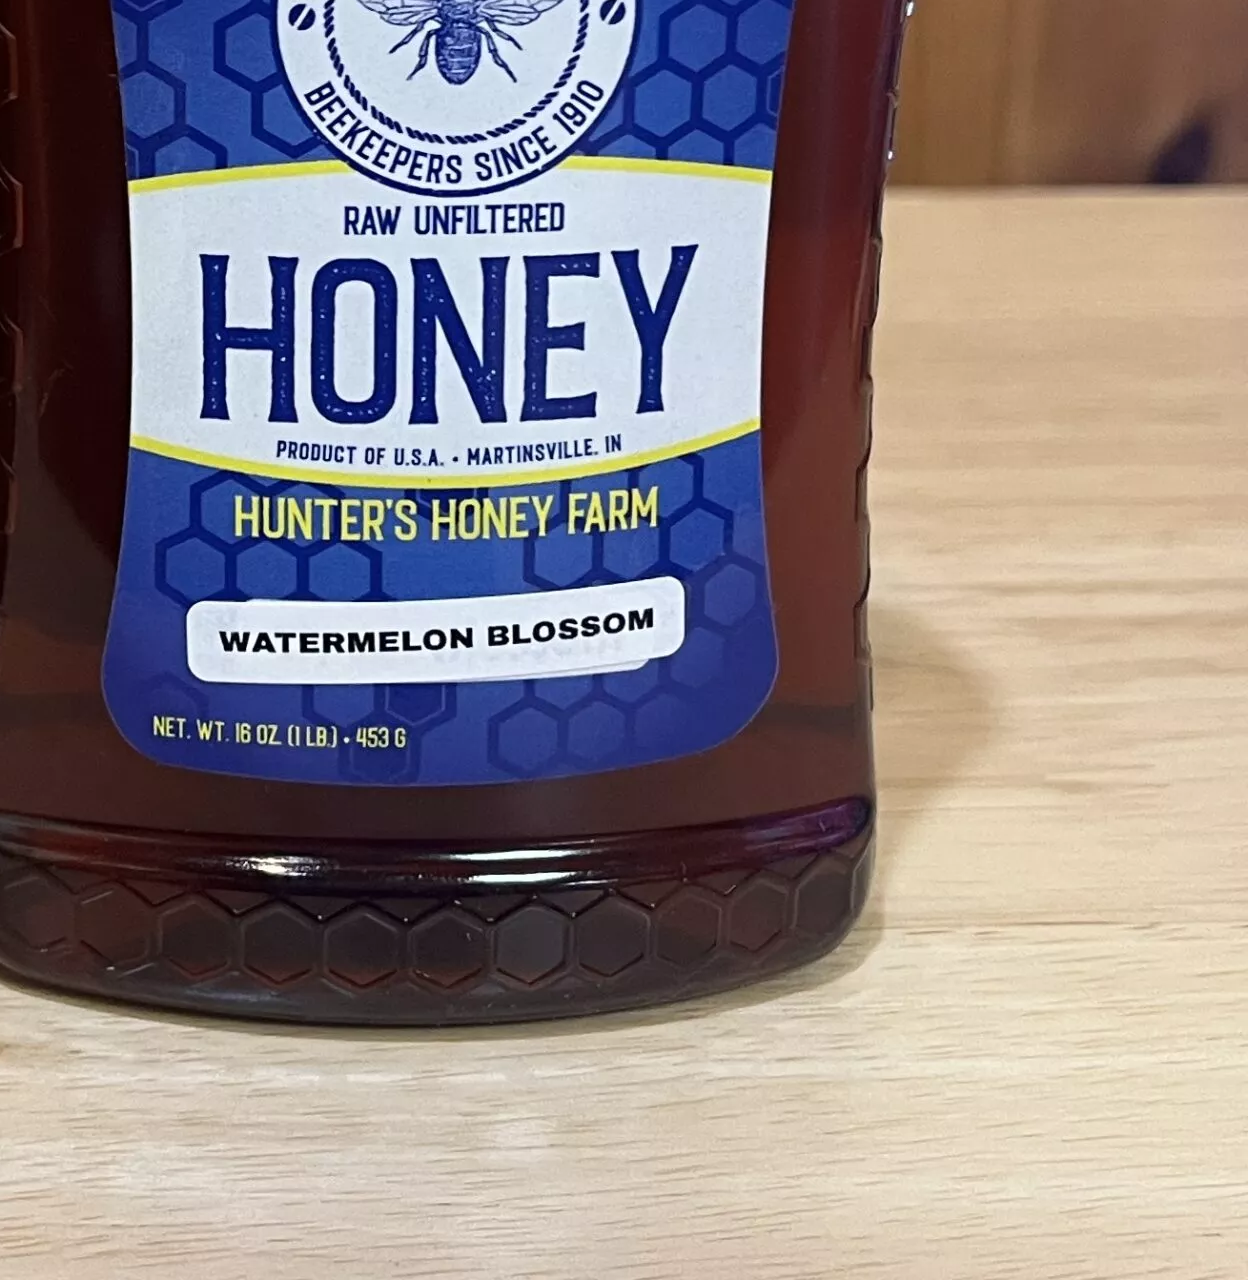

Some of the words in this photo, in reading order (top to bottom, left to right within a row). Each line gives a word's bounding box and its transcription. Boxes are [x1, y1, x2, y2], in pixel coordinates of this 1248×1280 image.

[304, 81, 462, 183] BEEKEEPERS
[474, 126, 557, 181] SINCE
[553, 80, 604, 135] 1910
[343, 206, 401, 235] RAW
[414, 202, 565, 235] UNFILTERED
[199, 243, 699, 425] HONEY
[276, 439, 356, 465] PRODUCT
[364, 447, 386, 465] OF
[394, 448, 444, 467] U.S.A.
[605, 434, 623, 454] IN
[233, 495, 418, 541] HUNTER'S
[431, 495, 554, 541] HONEY
[567, 486, 660, 535] FARM
[219, 628, 474, 654] WATERMELON
[487, 607, 654, 647] BLOSSOM
[152, 715, 192, 740] NET.
[196, 718, 230, 742] WT.
[235, 722, 252, 744] 16
[287, 725, 300, 747] (1
[306, 725, 338, 748] LB.)
[355, 726, 390, 748] 453
[394, 727, 407, 748] G
